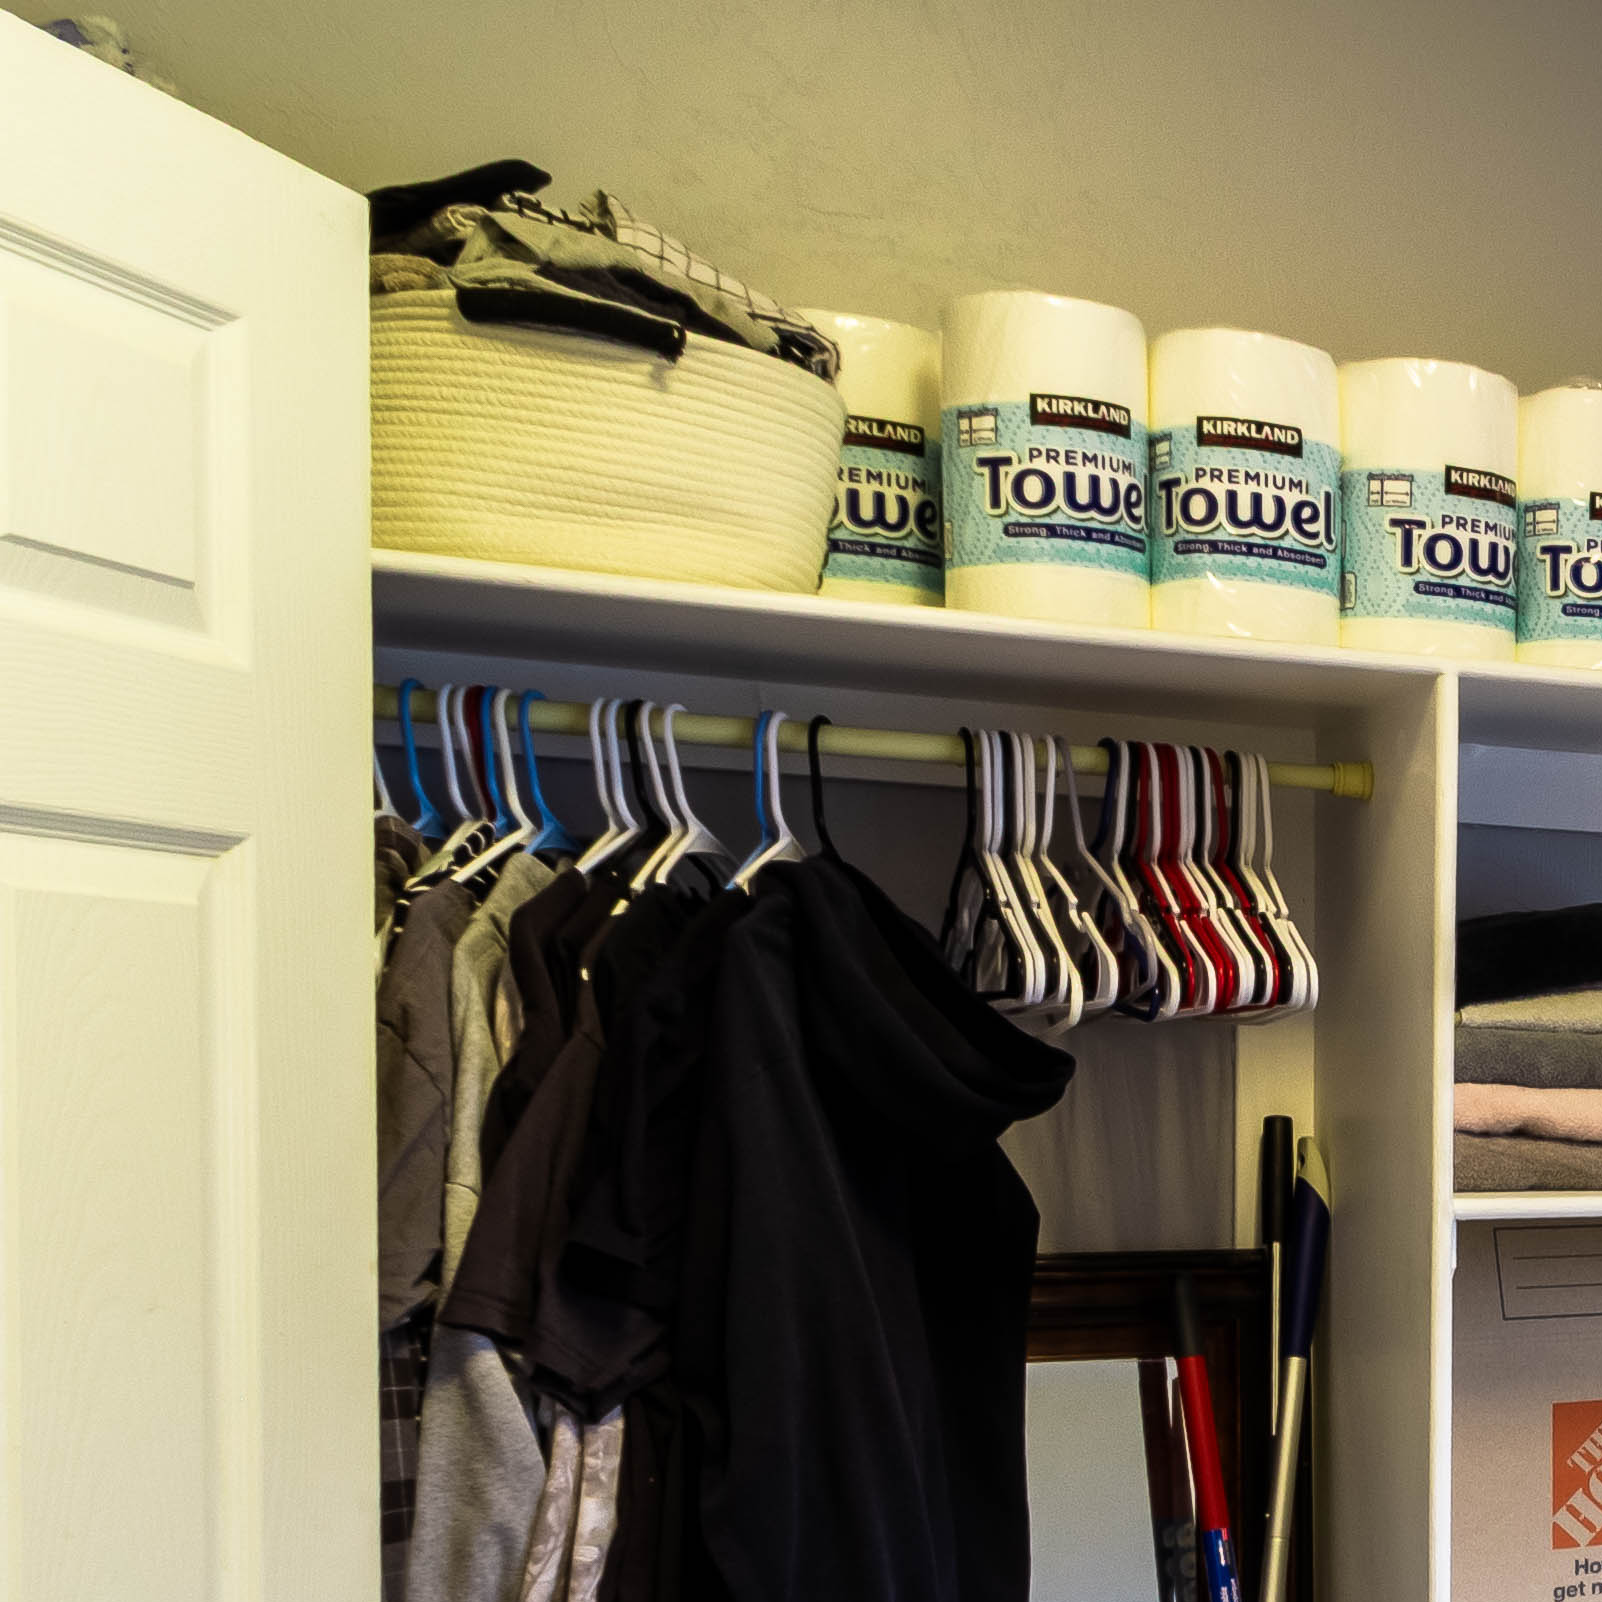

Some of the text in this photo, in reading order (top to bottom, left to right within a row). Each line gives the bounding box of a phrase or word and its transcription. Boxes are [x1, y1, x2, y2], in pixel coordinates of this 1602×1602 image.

[1036, 396, 1130, 426] KIRKLAND
[847, 417, 922, 443] RKLAND
[1202, 419, 1300, 445] KIRKLAND
[1028, 447, 1134, 477] PREMIUM
[837, 466, 927, 494] REMIUM
[1194, 467, 1304, 494] PREMIUM
[1159, 477, 1335, 546] Towel
[1055, 526, 1087, 537] Thick
[1217, 543, 1248, 553] Thick
[1252, 547, 1273, 556] and
[1276, 549, 1326, 565] Absorbent
[1389, 518, 1512, 582] Tow
[1460, 587, 1486, 599] Thick
[1553, 1581, 1586, 1602] get
